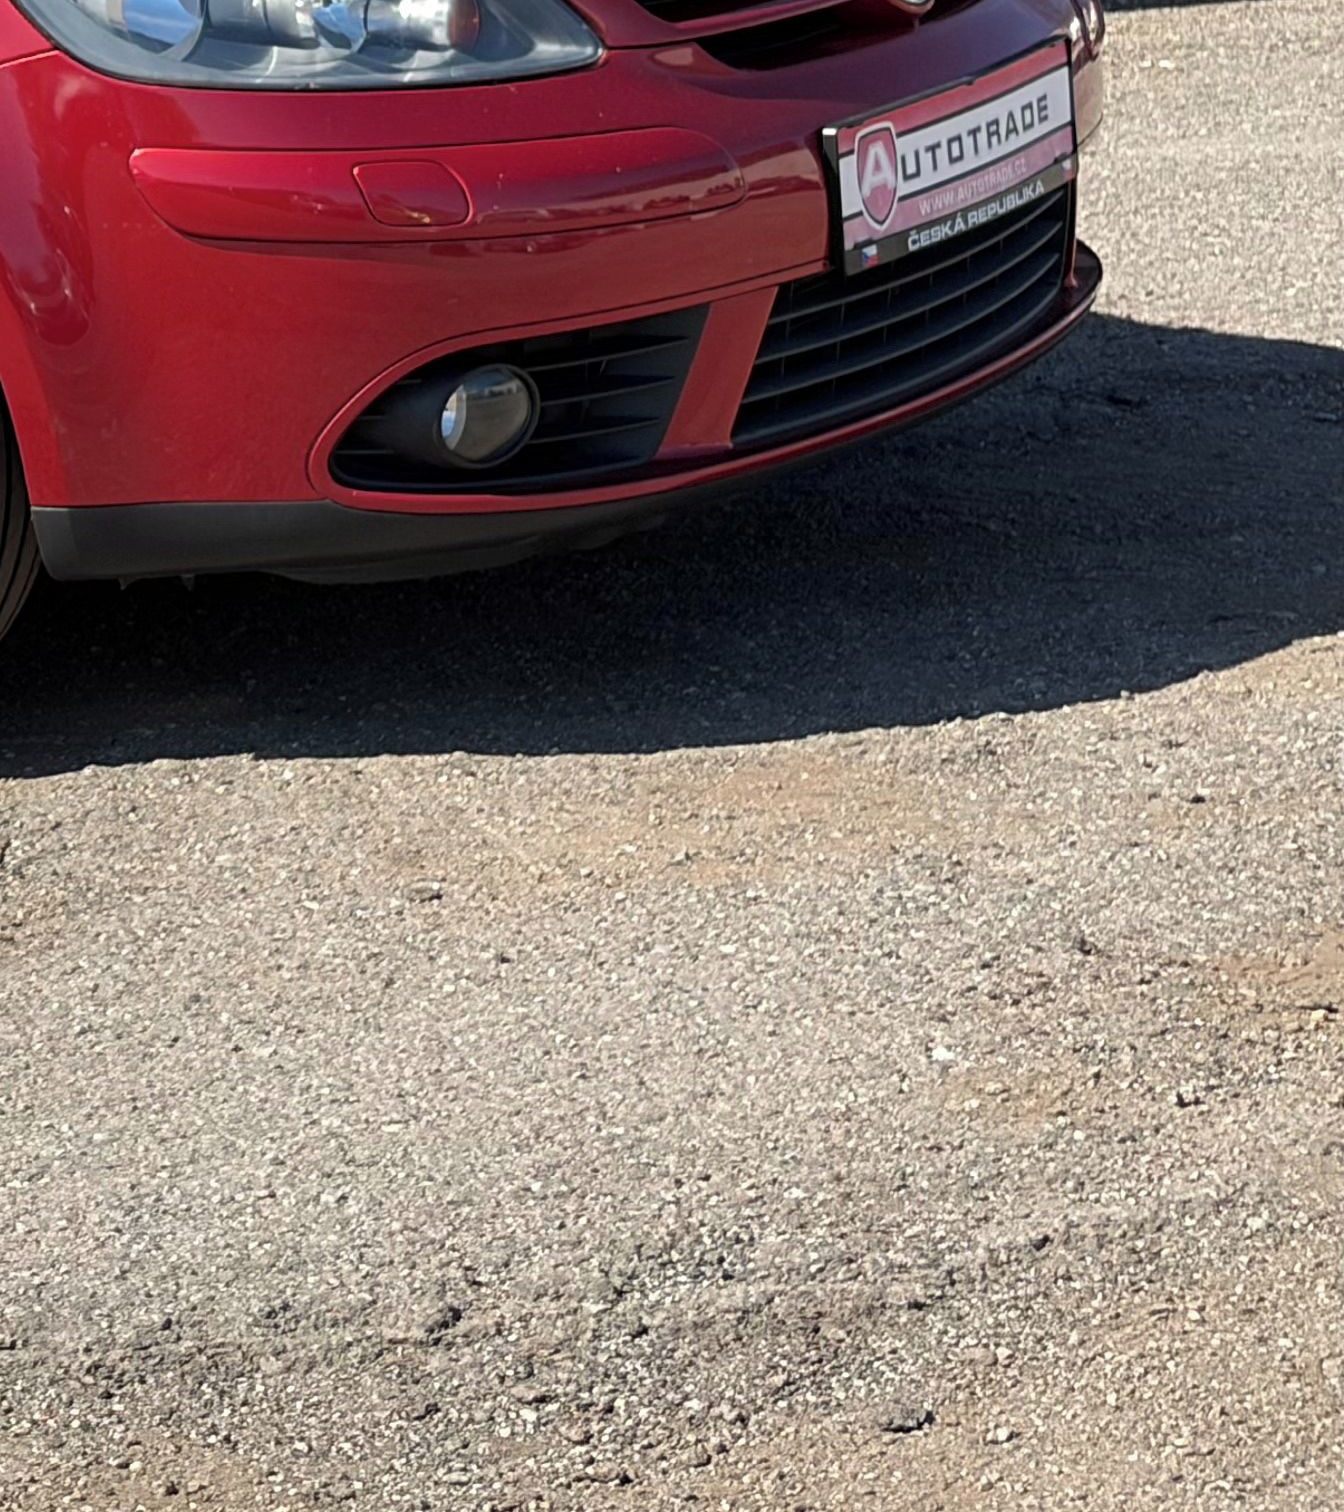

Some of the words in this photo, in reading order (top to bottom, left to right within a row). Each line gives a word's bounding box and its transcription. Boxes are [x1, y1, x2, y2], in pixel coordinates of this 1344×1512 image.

[907, 211, 966, 253] ČESKÁ
[966, 178, 1046, 229] REPUBLIKA
[918, 157, 1027, 217] WWW.AUTOTRADE.CZ
